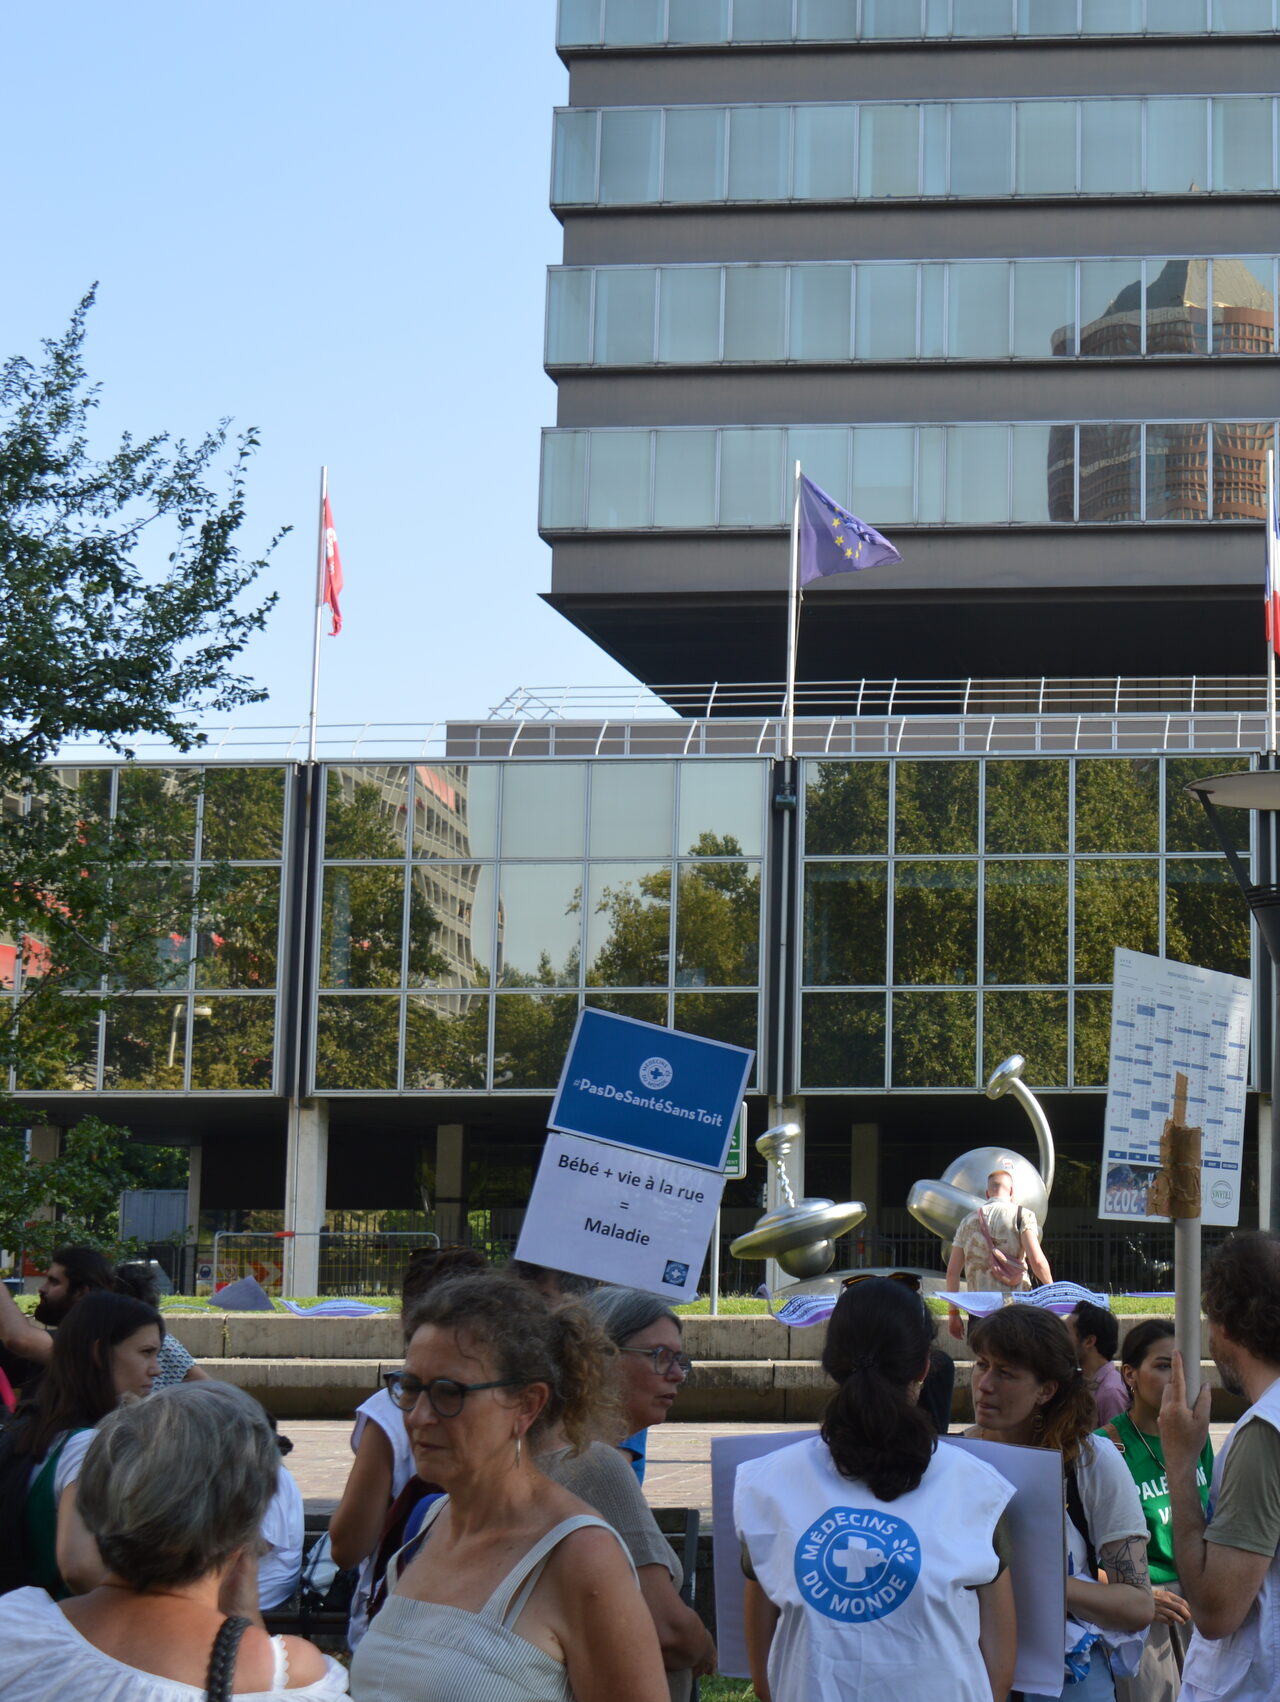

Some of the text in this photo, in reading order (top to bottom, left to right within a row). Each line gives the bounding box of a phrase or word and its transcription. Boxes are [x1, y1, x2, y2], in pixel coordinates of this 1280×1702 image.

[573, 1078, 723, 1127] #PasDeSantéSansToit
[558, 1154, 600, 1176] Bébé
[618, 1171, 641, 1187] vie
[645, 1175, 655, 1191] à
[659, 1179, 674, 1196] la
[677, 1186, 705, 1203] rue
[1105, 1189, 1139, 1213] 2023
[584, 1217, 650, 1246] Maladie
[801, 1512, 899, 1561] MÉDECINS
[802, 1570, 907, 1615] DU MONDE
